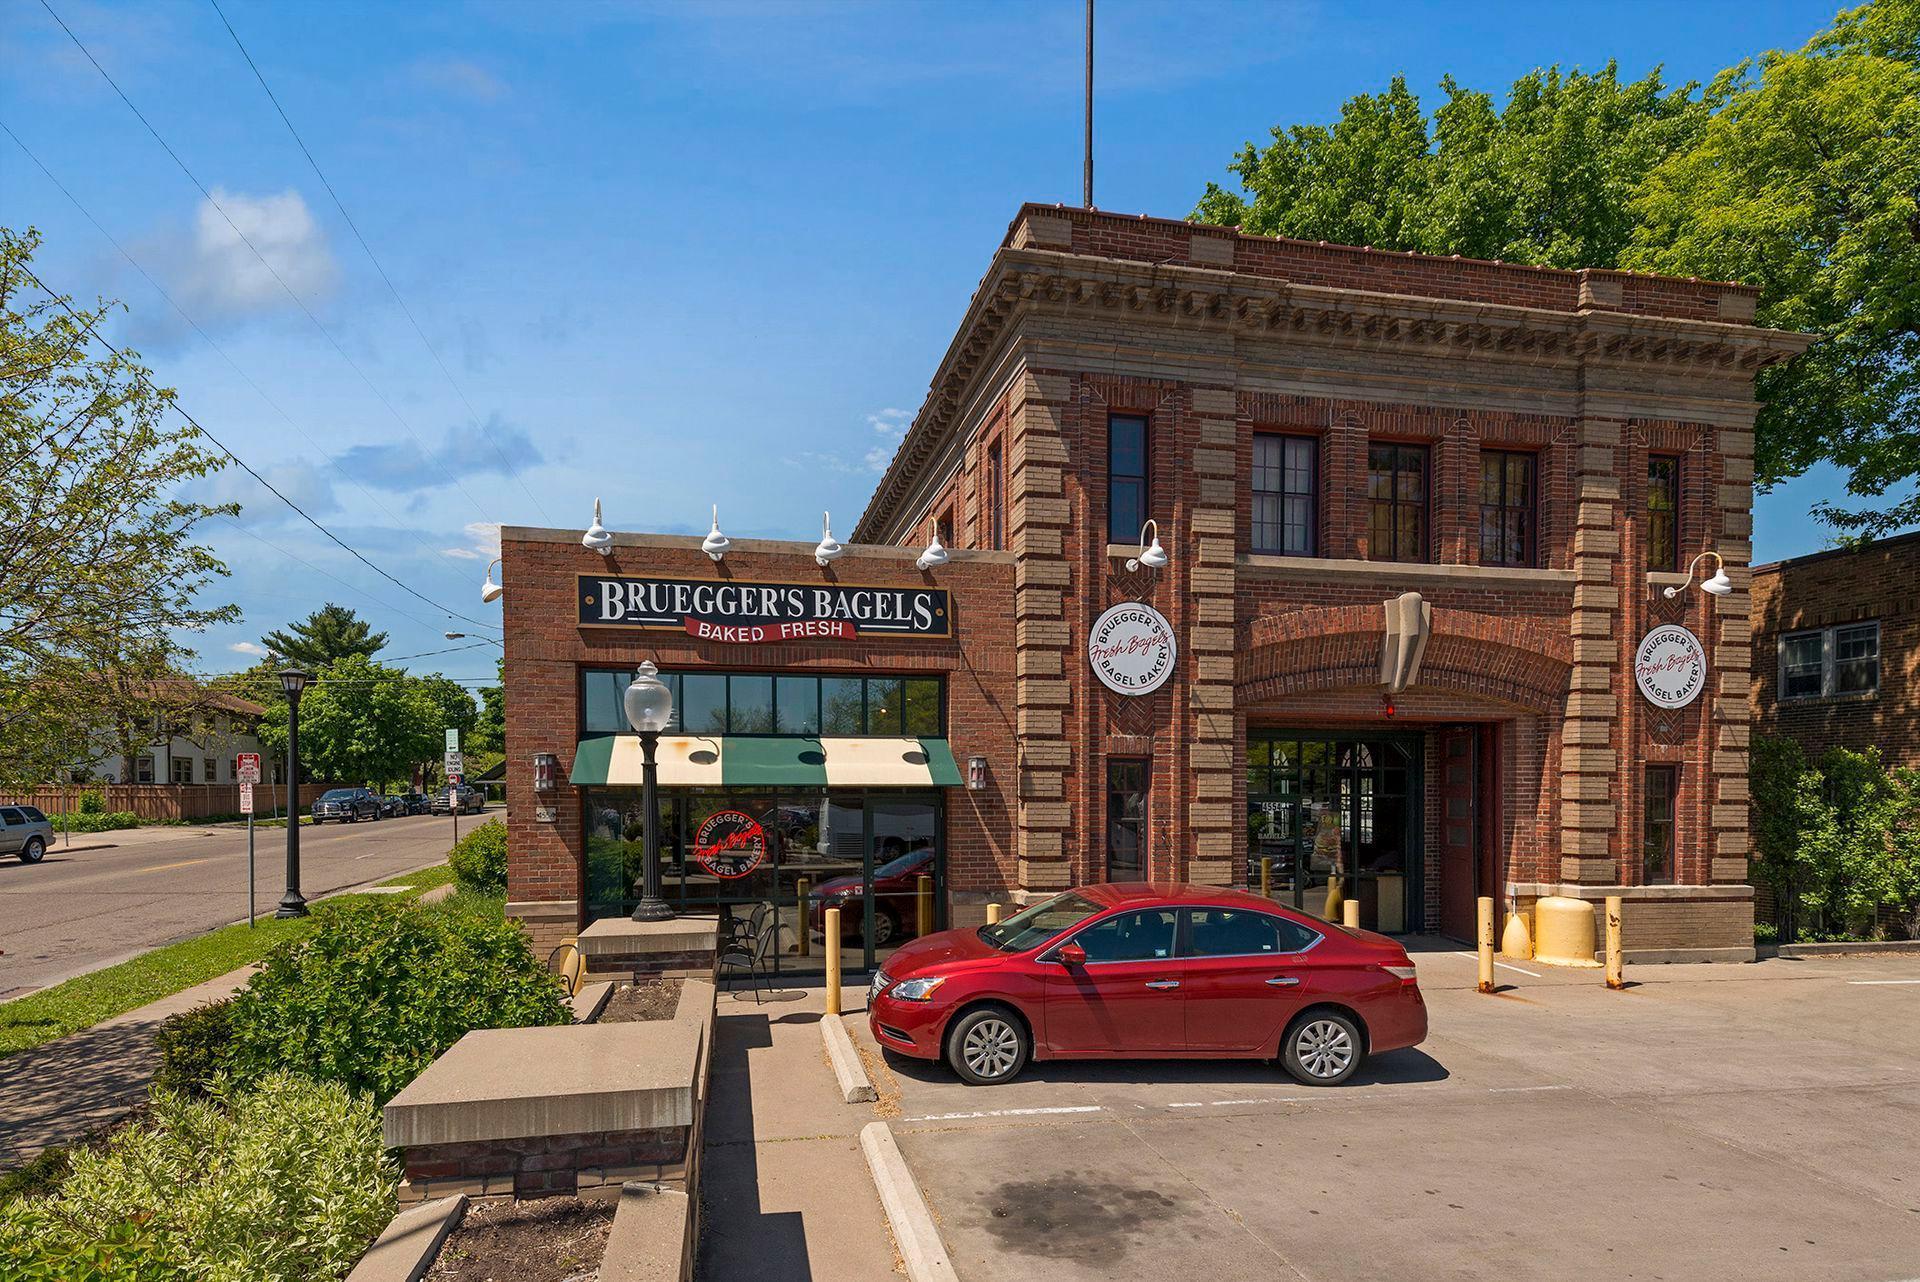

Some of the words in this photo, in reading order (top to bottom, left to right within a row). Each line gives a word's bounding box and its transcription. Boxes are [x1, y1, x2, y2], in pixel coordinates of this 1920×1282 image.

[598, 580, 804, 621] BRUEGGER'S
[813, 588, 933, 631] BAGELS
[697, 622, 765, 642] BAKED
[780, 620, 844, 638] FRESH
[1098, 612, 1161, 644] BRUEGGER'S
[1089, 640, 1128, 663] Fresh
[1643, 633, 1694, 662] BRUEGGER'S
[1101, 659, 1135, 686] BAGEL
[1139, 643, 1168, 684] BAKERY
[1644, 676, 1672, 700] BAGEL
[1675, 662, 1699, 699] BAKERY
[699, 814, 753, 844] BRUEGGER'S
[704, 856, 737, 875] BAGEL
[739, 836, 762, 872] BAKERY
